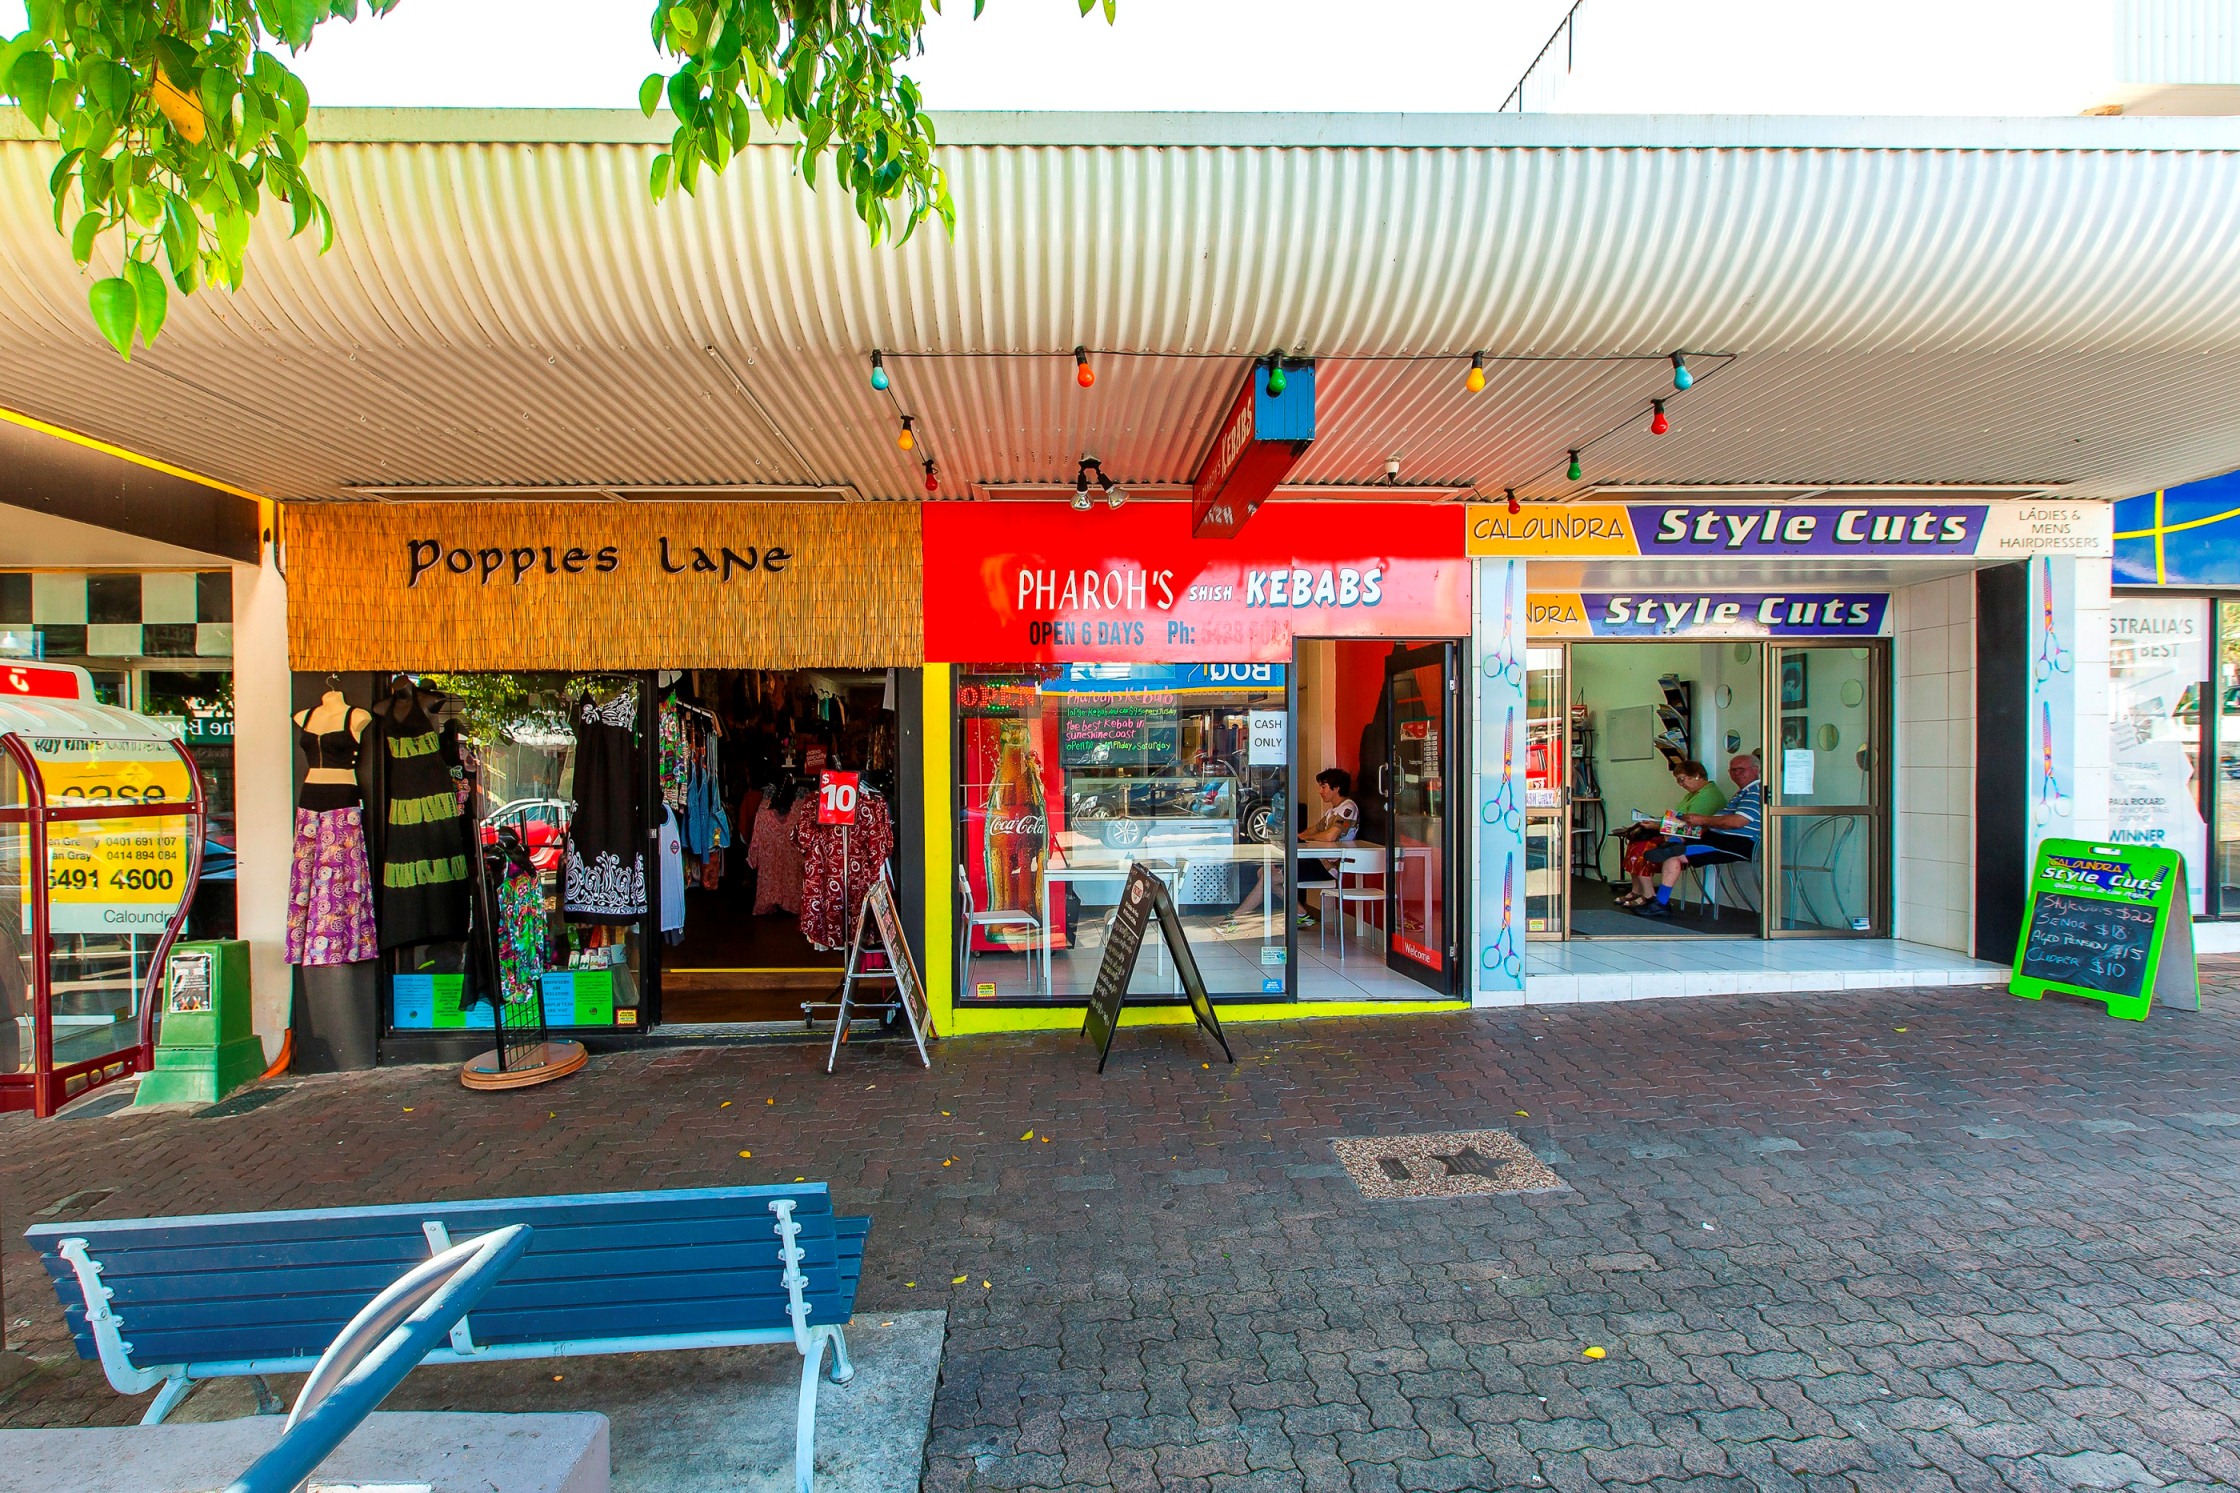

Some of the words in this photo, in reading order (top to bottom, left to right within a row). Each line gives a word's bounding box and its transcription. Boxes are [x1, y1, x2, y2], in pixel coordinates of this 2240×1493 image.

[1221, 396, 1252, 478] KEBABS
[2019, 510, 2067, 521] LADIES
[2071, 510, 2081, 521] &
[1474, 513, 1625, 540] CALOUNDRA
[1655, 508, 1817, 549] Style
[1834, 509, 1967, 545] Cuts
[2031, 523, 2071, 534] MENS
[2000, 537, 2099, 548] HAIRDRESSERS
[407, 539, 619, 588] Poppies
[1018, 569, 1174, 611] PHAROH'S
[1188, 585, 1233, 602] SHISH
[1246, 568, 1383, 608] KEBABS
[1526, 604, 1578, 624] NDRA
[1604, 597, 1740, 629] Style
[1757, 597, 1870, 625] Cuts
[1029, 621, 1075, 646] OPEN
[1081, 621, 1092, 645] 6
[1099, 621, 1145, 646] DAYS
[1168, 621, 1196, 645] Ph:
[2140, 643, 2180, 657] BEST
[960, 685, 1034, 708] OPEN
[1066, 720, 1080, 731] the
[1082, 720, 1102, 731] best
[1136, 719, 1145, 729] in
[1254, 719, 1282, 729] CASH
[1137, 742, 1170, 751] Saturday
[1254, 738, 1282, 747] ONLY
[62, 785, 166, 804] ease
[821, 784, 857, 812] 10
[990, 815, 1046, 836] Coca-Cola
[2109, 829, 2165, 842] WINNER
[106, 837, 131, 846] 0401
[136, 837, 153, 846] 691
[68, 851, 92, 862] Gray
[107, 851, 133, 860] 0414
[136, 851, 154, 860] 894
[2049, 857, 2122, 873] CALOUNDRA
[110, 868, 173, 890] 4600
[2041, 867, 2100, 884] Style
[2107, 874, 2162, 891] Cuts
[2115, 906, 2155, 923] $22
[1404, 941, 1431, 963] Welcome
[2088, 956, 2126, 977] $10
